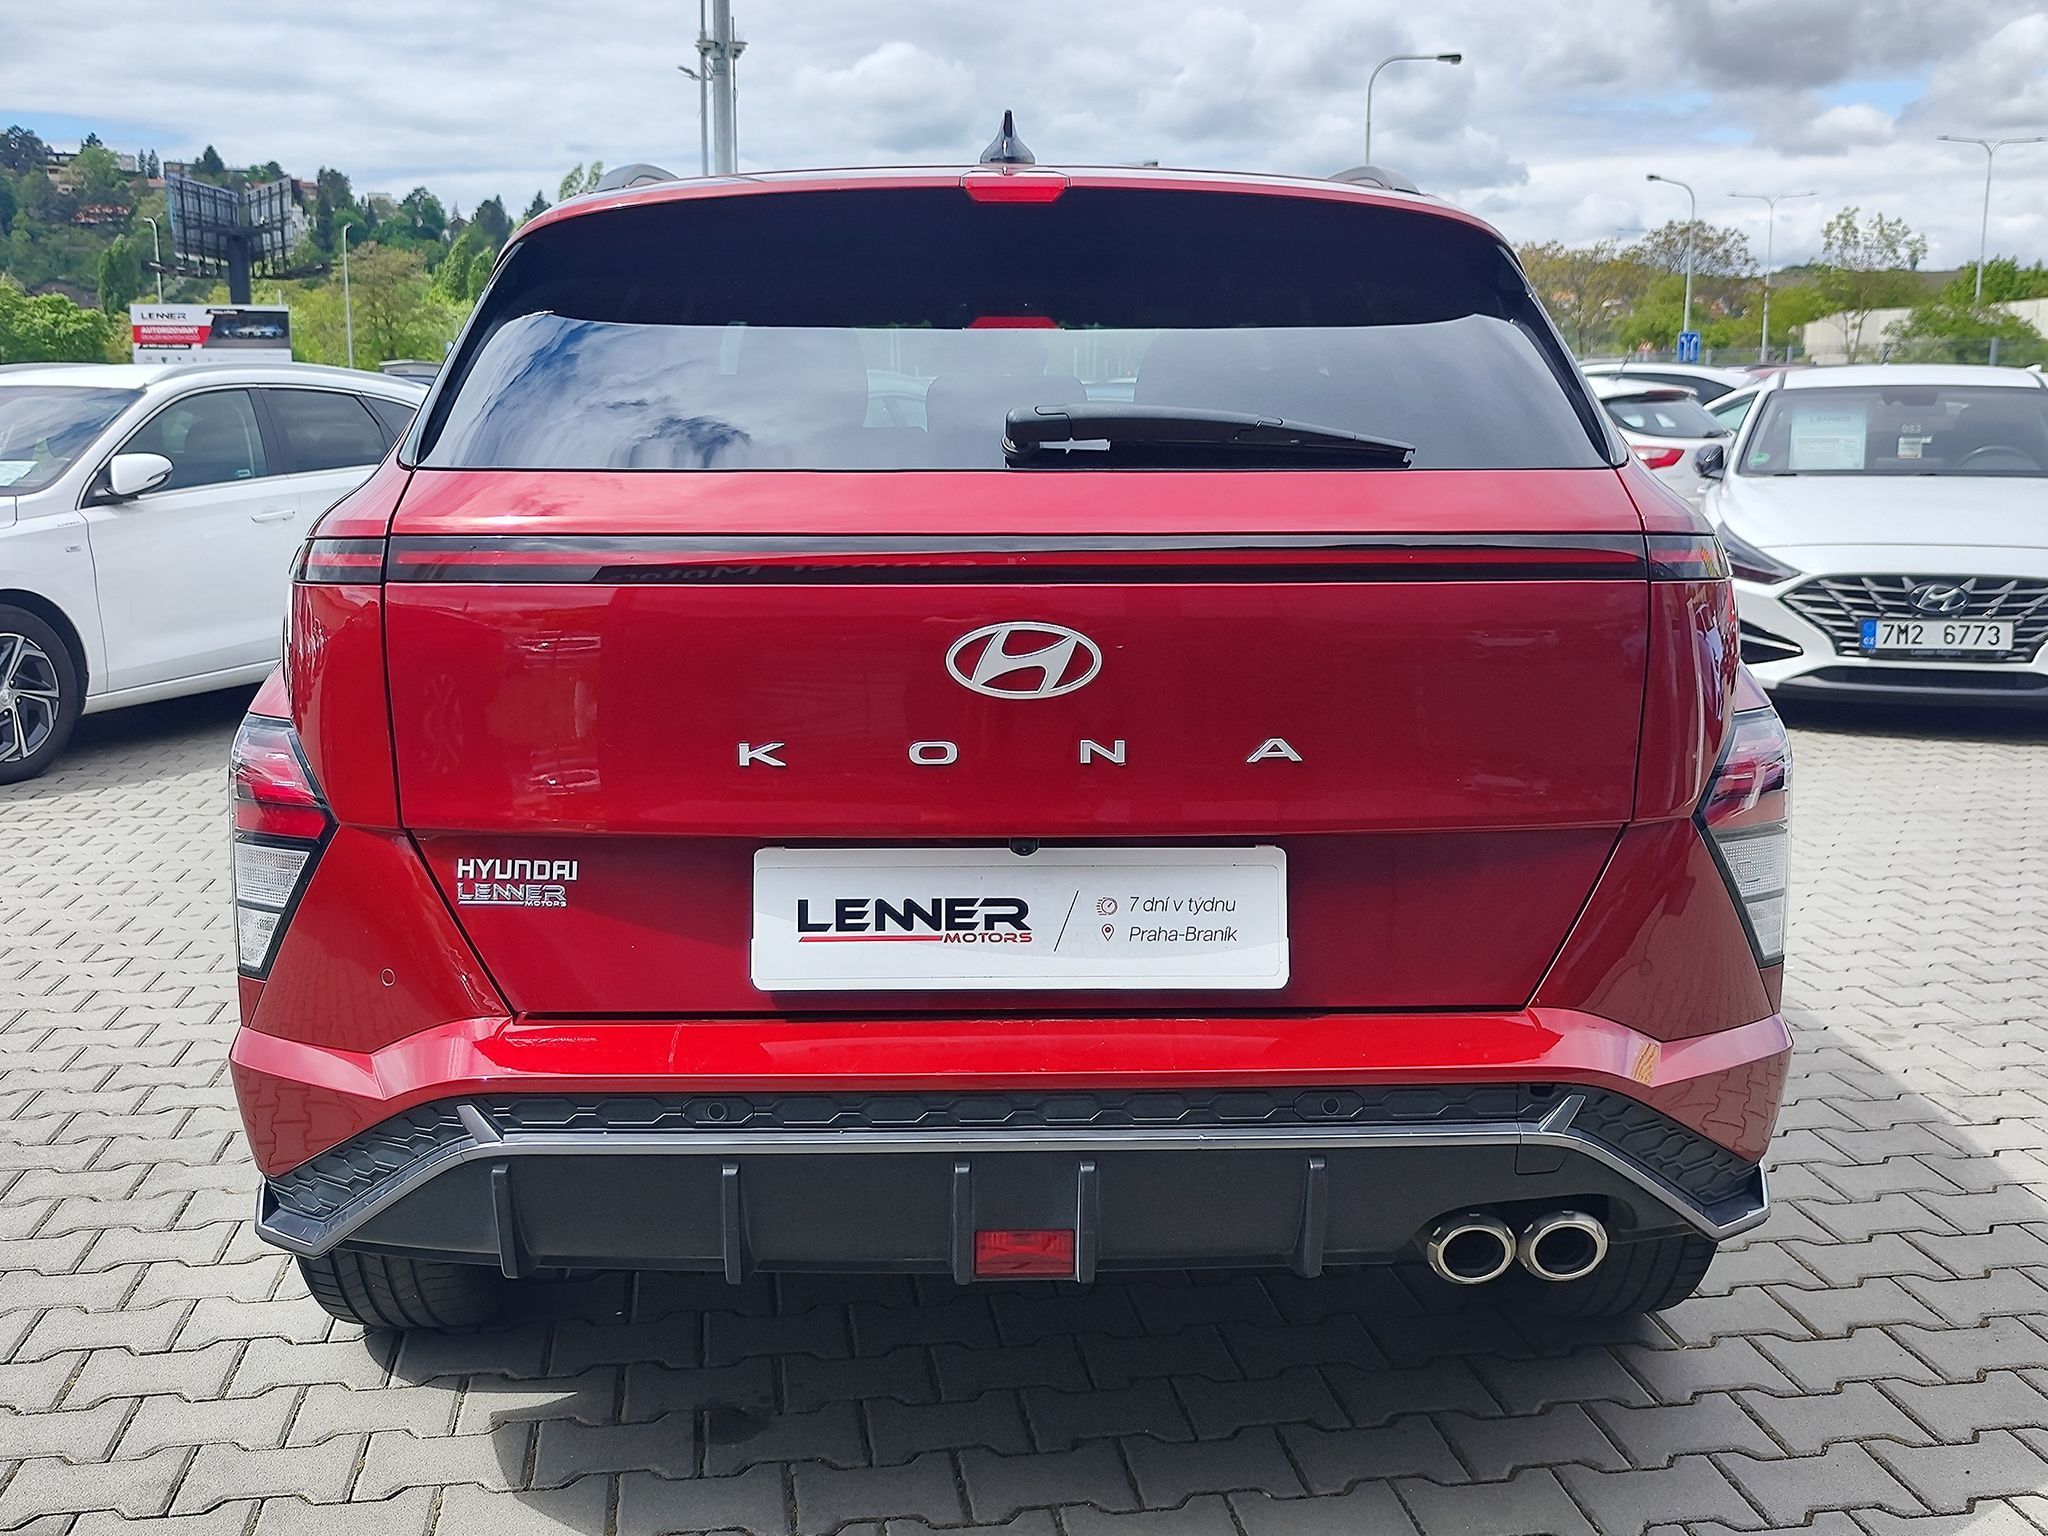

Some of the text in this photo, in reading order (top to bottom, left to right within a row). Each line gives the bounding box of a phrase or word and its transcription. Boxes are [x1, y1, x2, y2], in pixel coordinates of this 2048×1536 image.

[141, 312, 187, 320] LENNER
[1882, 624, 2001, 646] 7M2 6773
[457, 858, 578, 881] HYUNDAI
[457, 882, 567, 901] LENNER
[798, 897, 1032, 932] LENNER
[1129, 896, 1237, 916] 7 dní v týdnu
[943, 932, 1033, 943] MOTORS
[1128, 925, 1238, 942] Praha-Braník
